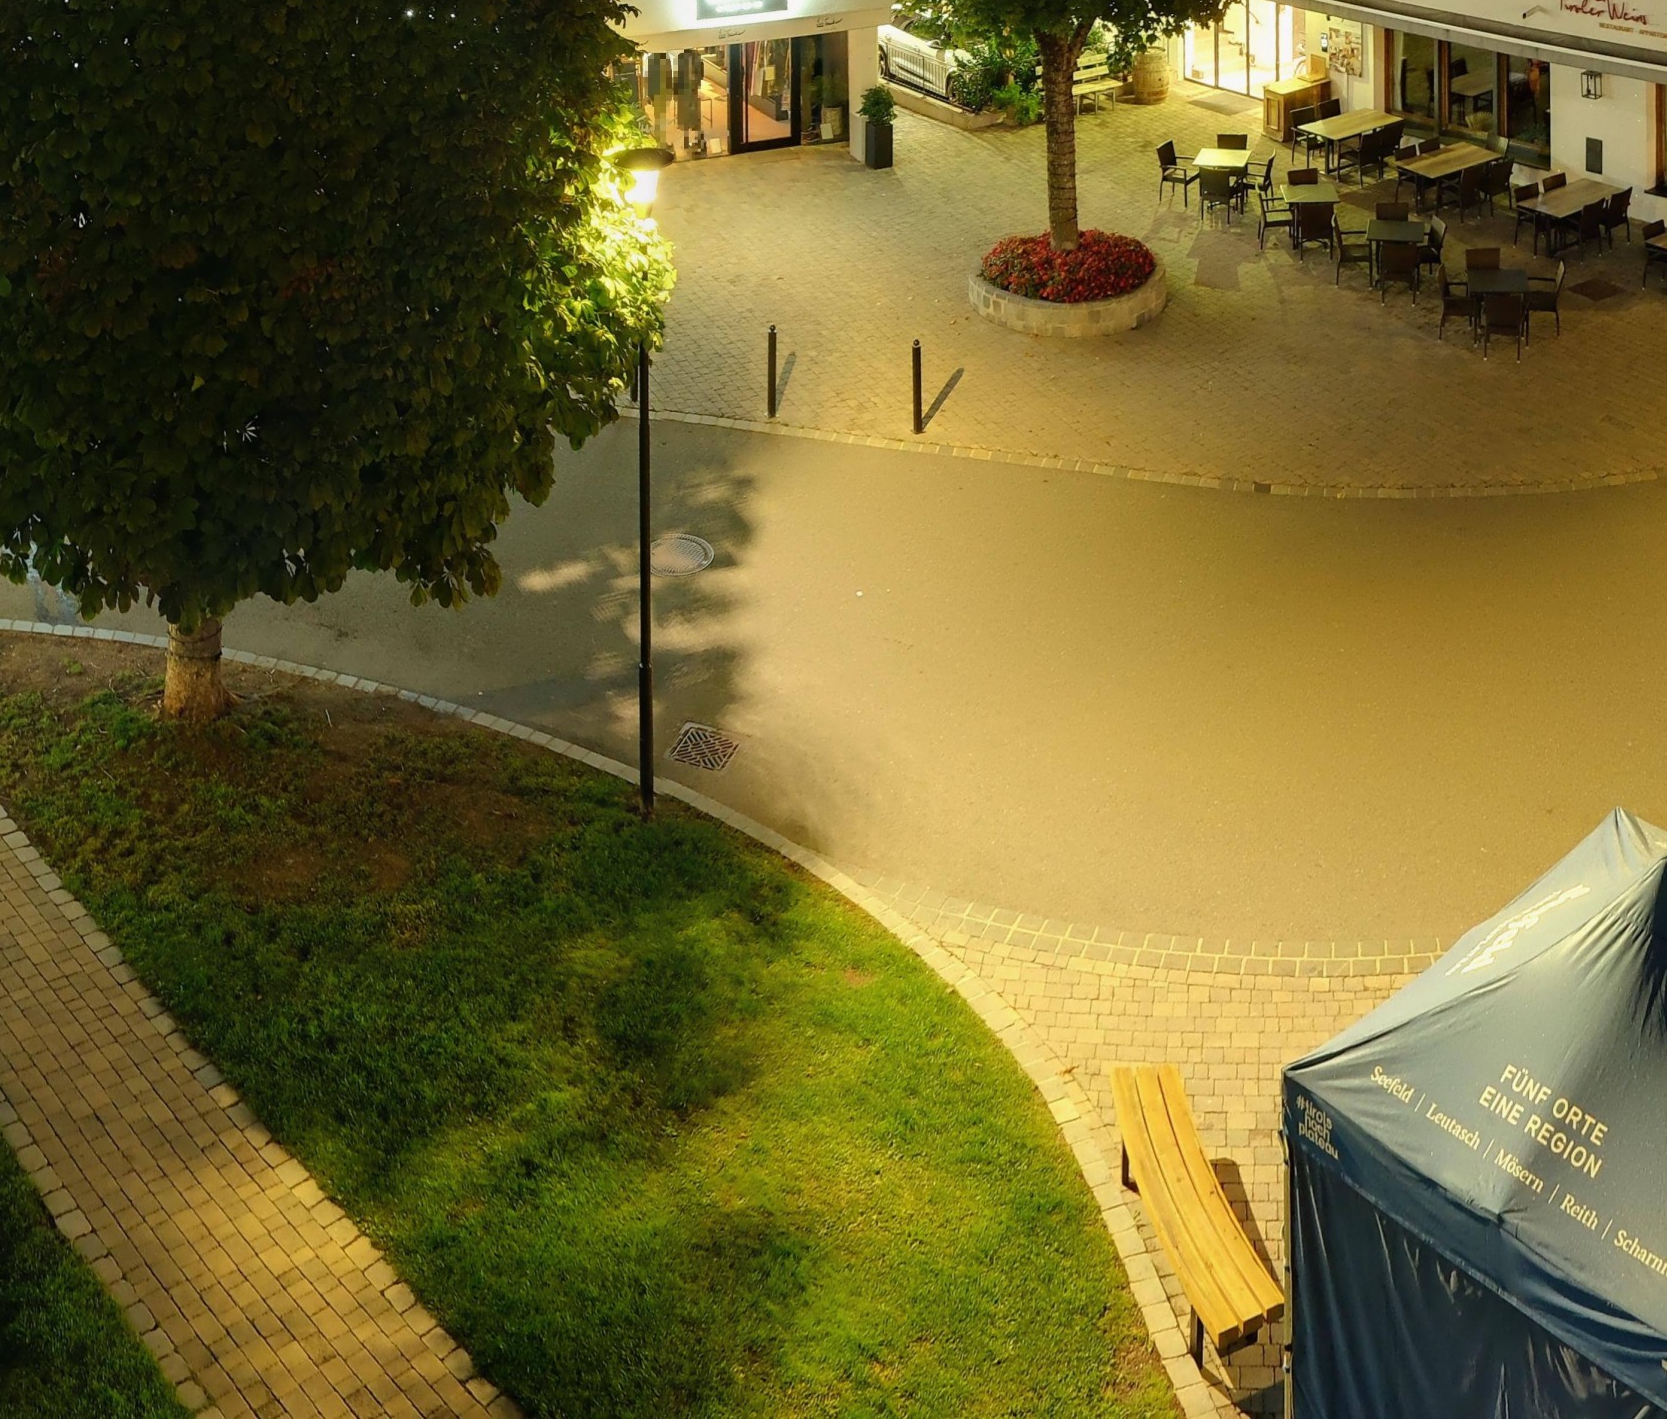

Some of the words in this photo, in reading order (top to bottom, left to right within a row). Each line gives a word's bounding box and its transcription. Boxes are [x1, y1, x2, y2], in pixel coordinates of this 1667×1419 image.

[1298, 1121, 1339, 1161] plateau
[1305, 1110, 1331, 1143] hoch
[1478, 1086, 1521, 1127] EINE
[1525, 1114, 1605, 1180] REGION
[1500, 1064, 1553, 1107] FÜNF
[1553, 1097, 1610, 1148] ORTE
[1370, 1066, 1415, 1104] Seefeld
[1425, 1103, 1481, 1152] Leutasch
[1494, 1148, 1546, 1194] Mösern
[1560, 1193, 1600, 1231] Reith
